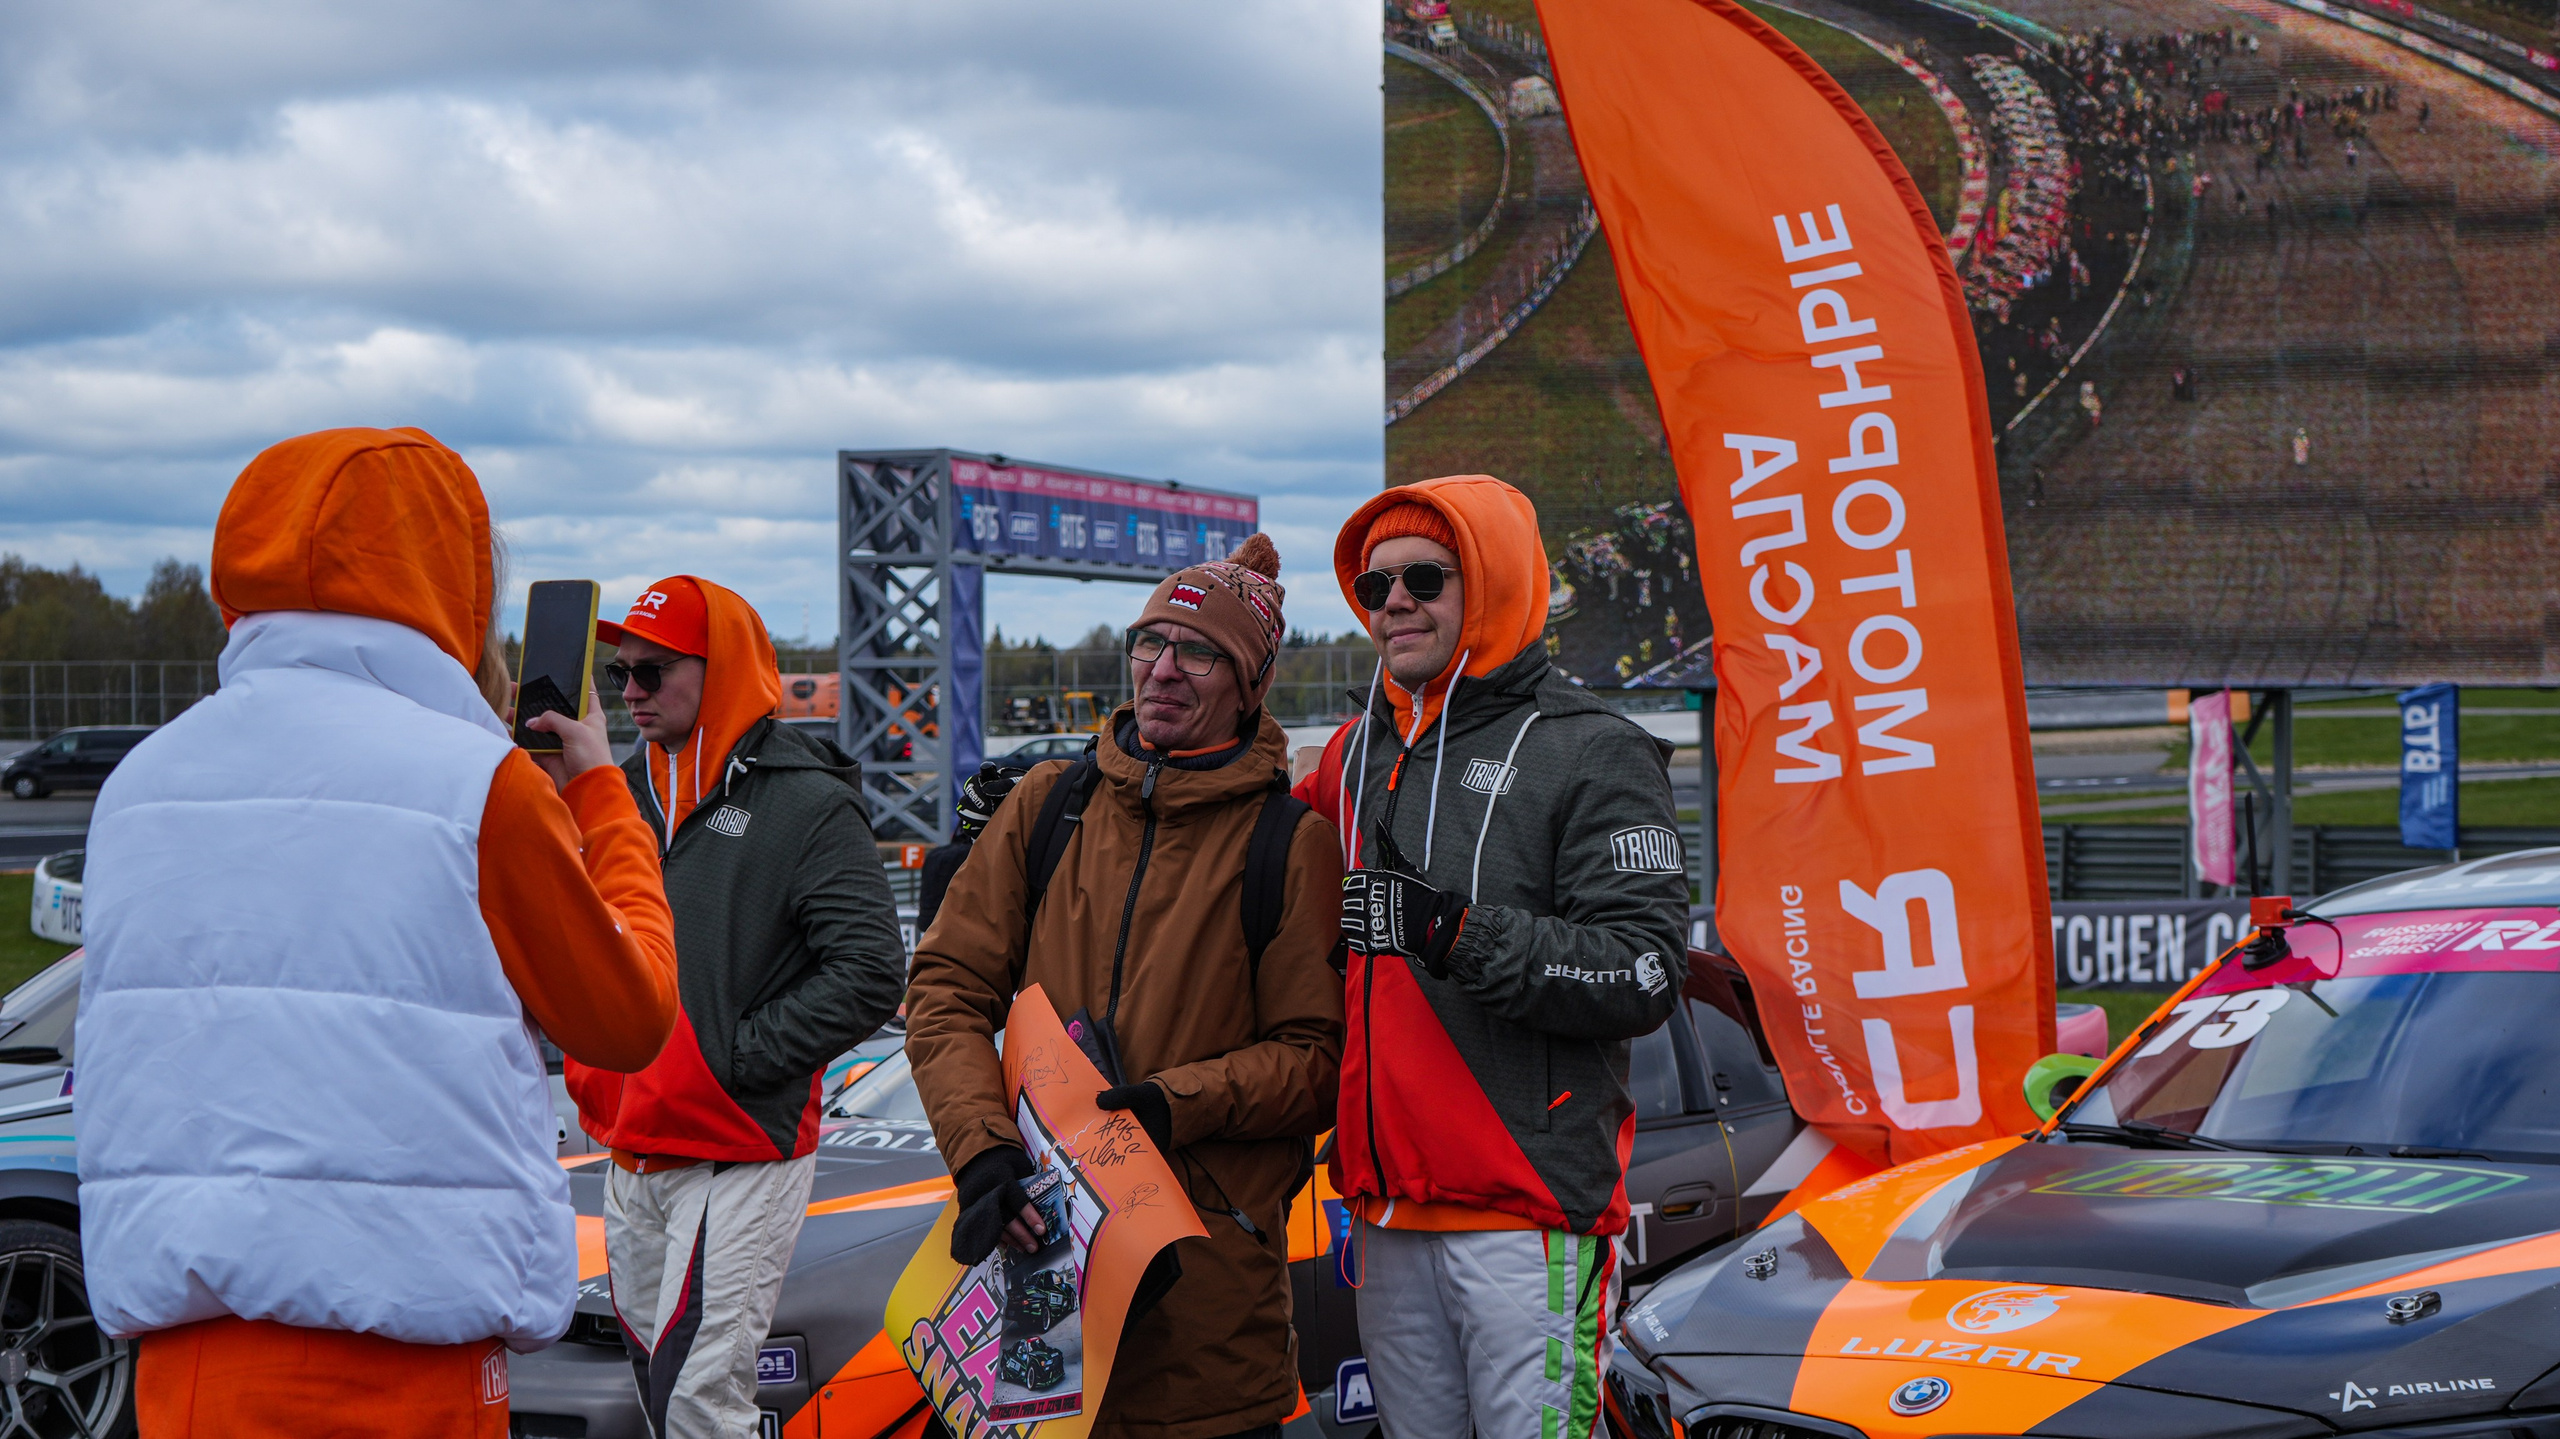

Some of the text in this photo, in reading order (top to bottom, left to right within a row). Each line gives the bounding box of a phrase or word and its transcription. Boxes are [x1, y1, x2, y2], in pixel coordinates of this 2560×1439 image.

[1466, 762, 1514, 792] TRIAI
[906, 846, 920, 867] F
[1615, 829, 1679, 870] TRIALLI
[1370, 882, 1391, 949] freem
[1397, 910, 1406, 947] CARVILLE
[2362, 921, 2472, 939] RUSSIAN
[2378, 932, 2455, 946] DRIFT
[2349, 942, 2436, 959] SERIES
[1544, 963, 1632, 984] LUZAR
[2133, 988, 2291, 1059] 73
[1840, 1337, 2082, 1375] LUZAR
[2388, 1377, 2497, 1397] AIRLINE
